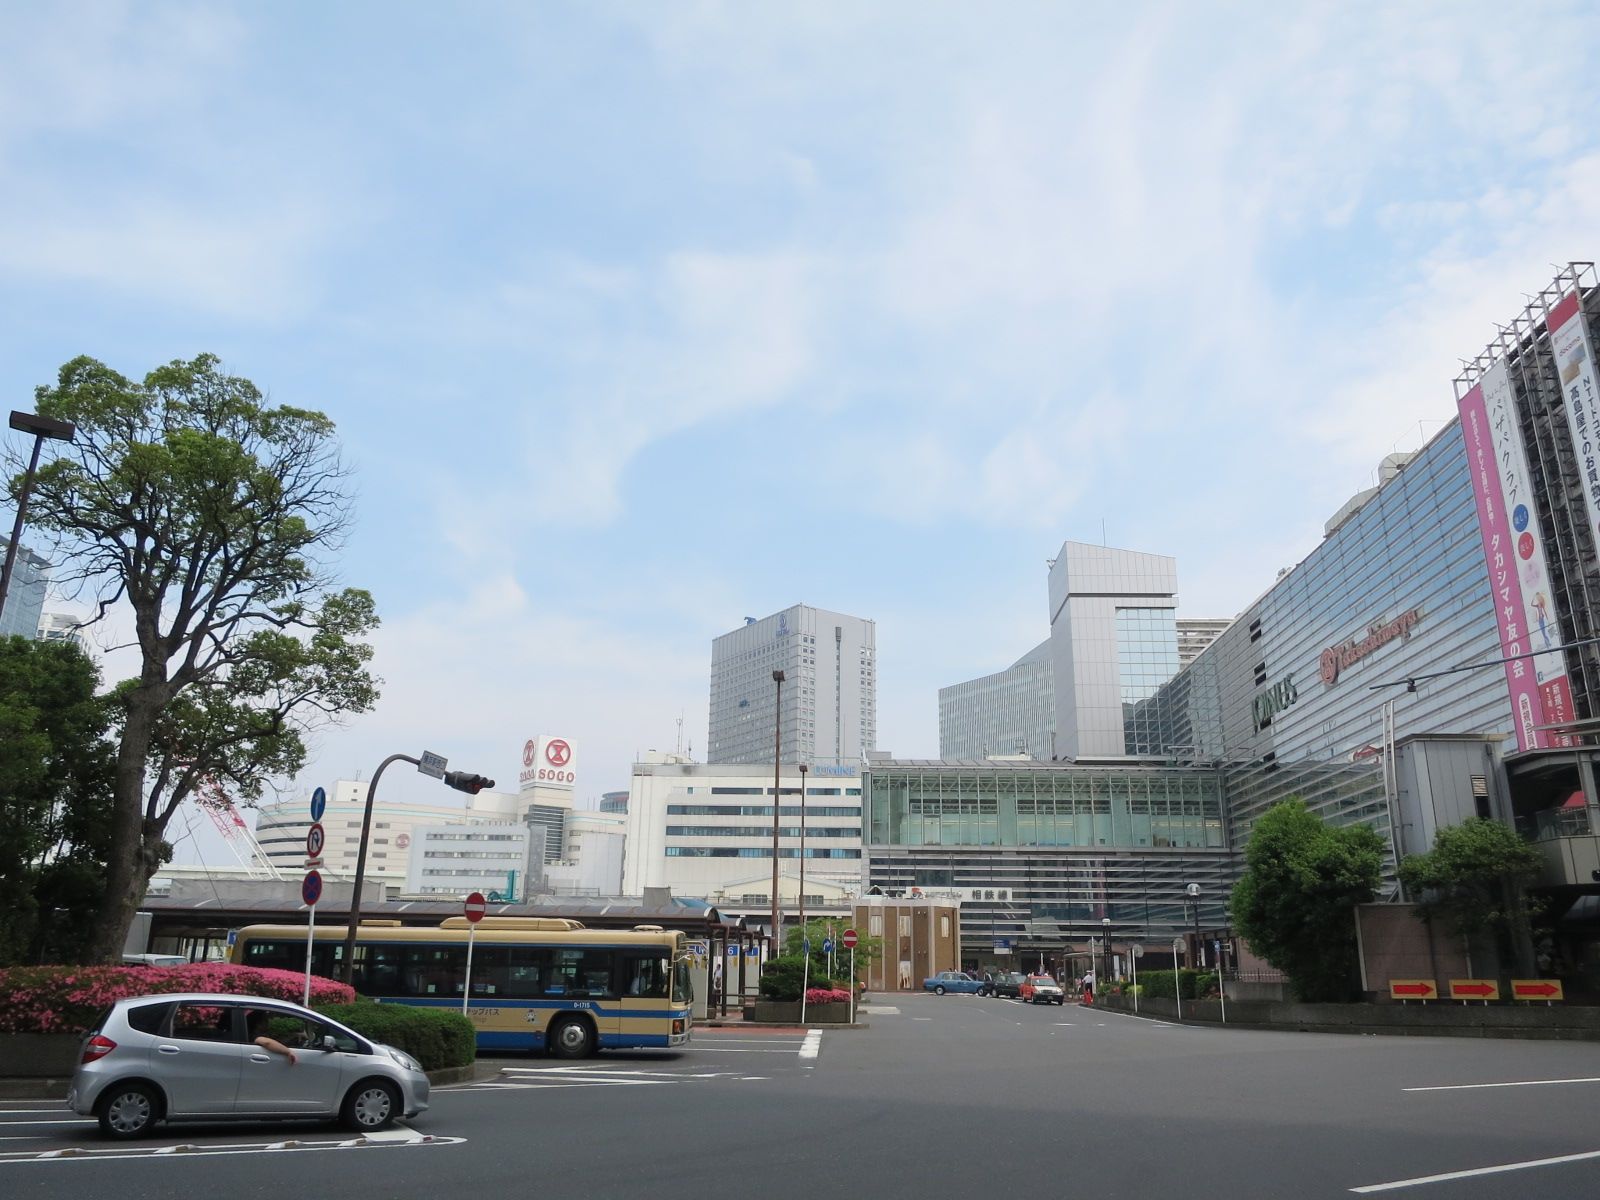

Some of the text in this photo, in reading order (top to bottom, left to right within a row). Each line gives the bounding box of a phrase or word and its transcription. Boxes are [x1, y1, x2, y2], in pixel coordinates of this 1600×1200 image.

[1491, 533, 1525, 679] タカシマヤ友の会
[538, 768, 575, 783] SOGO
[727, 946, 734, 955] 6
